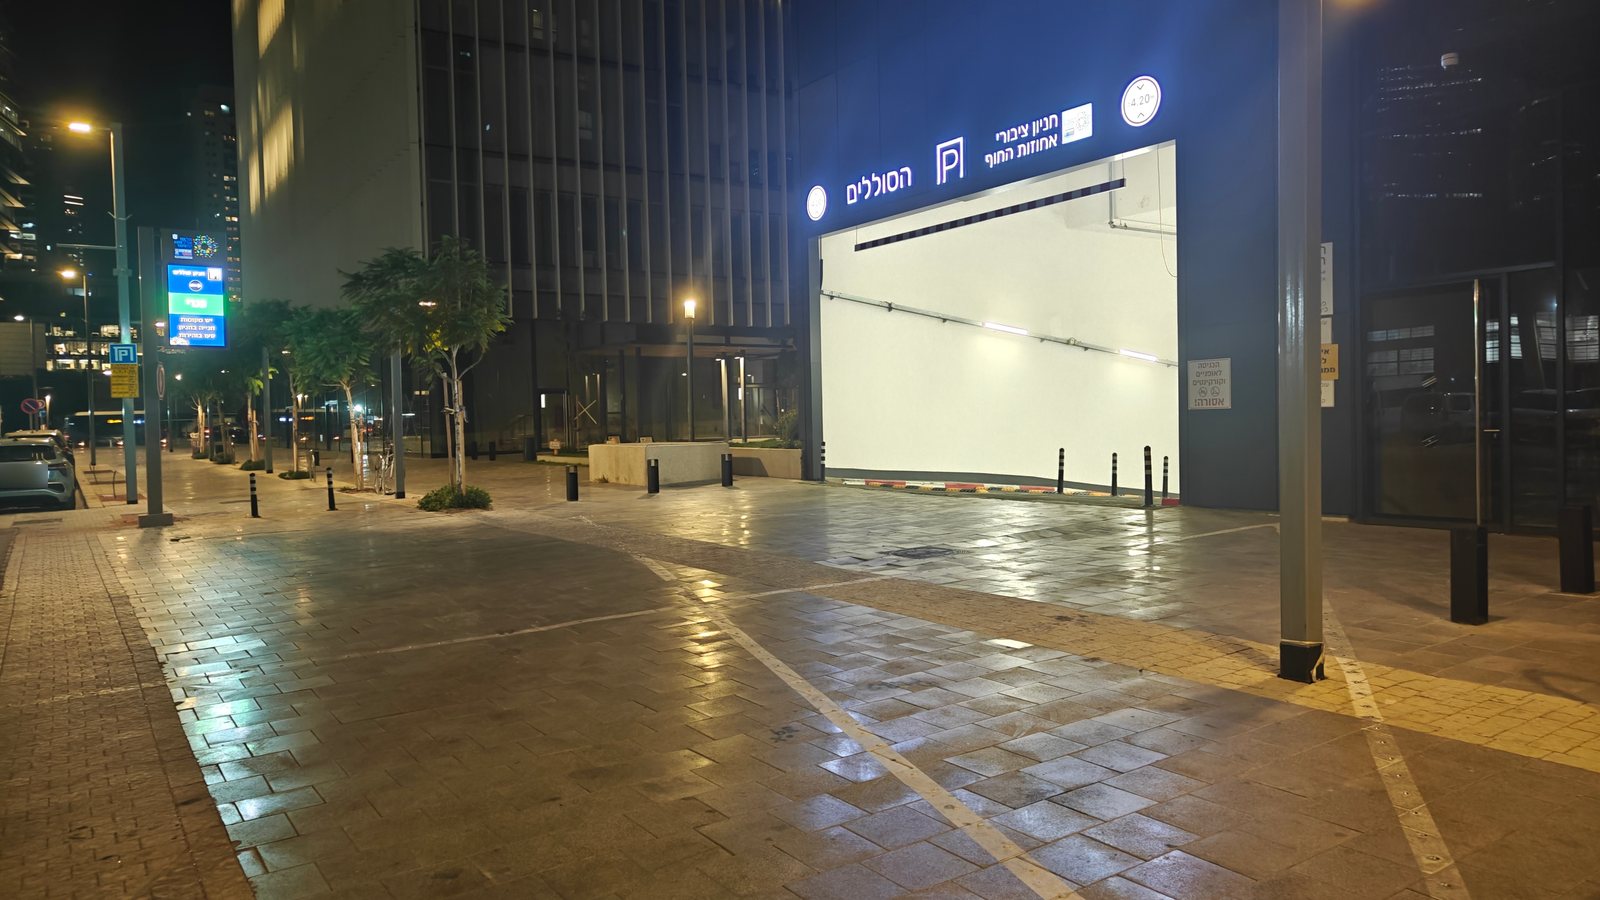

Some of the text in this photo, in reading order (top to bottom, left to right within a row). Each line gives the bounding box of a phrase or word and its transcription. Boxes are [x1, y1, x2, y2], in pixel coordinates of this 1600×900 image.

[995, 114, 1059, 144] חניון ציבורי
[984, 133, 1058, 168] אחוזות החוף
[846, 166, 912, 205] הסוללים
[1195, 369, 1223, 378] לאופניים
[1197, 361, 1220, 369] הכניסה
[1194, 397, 1225, 407] אסורה!
